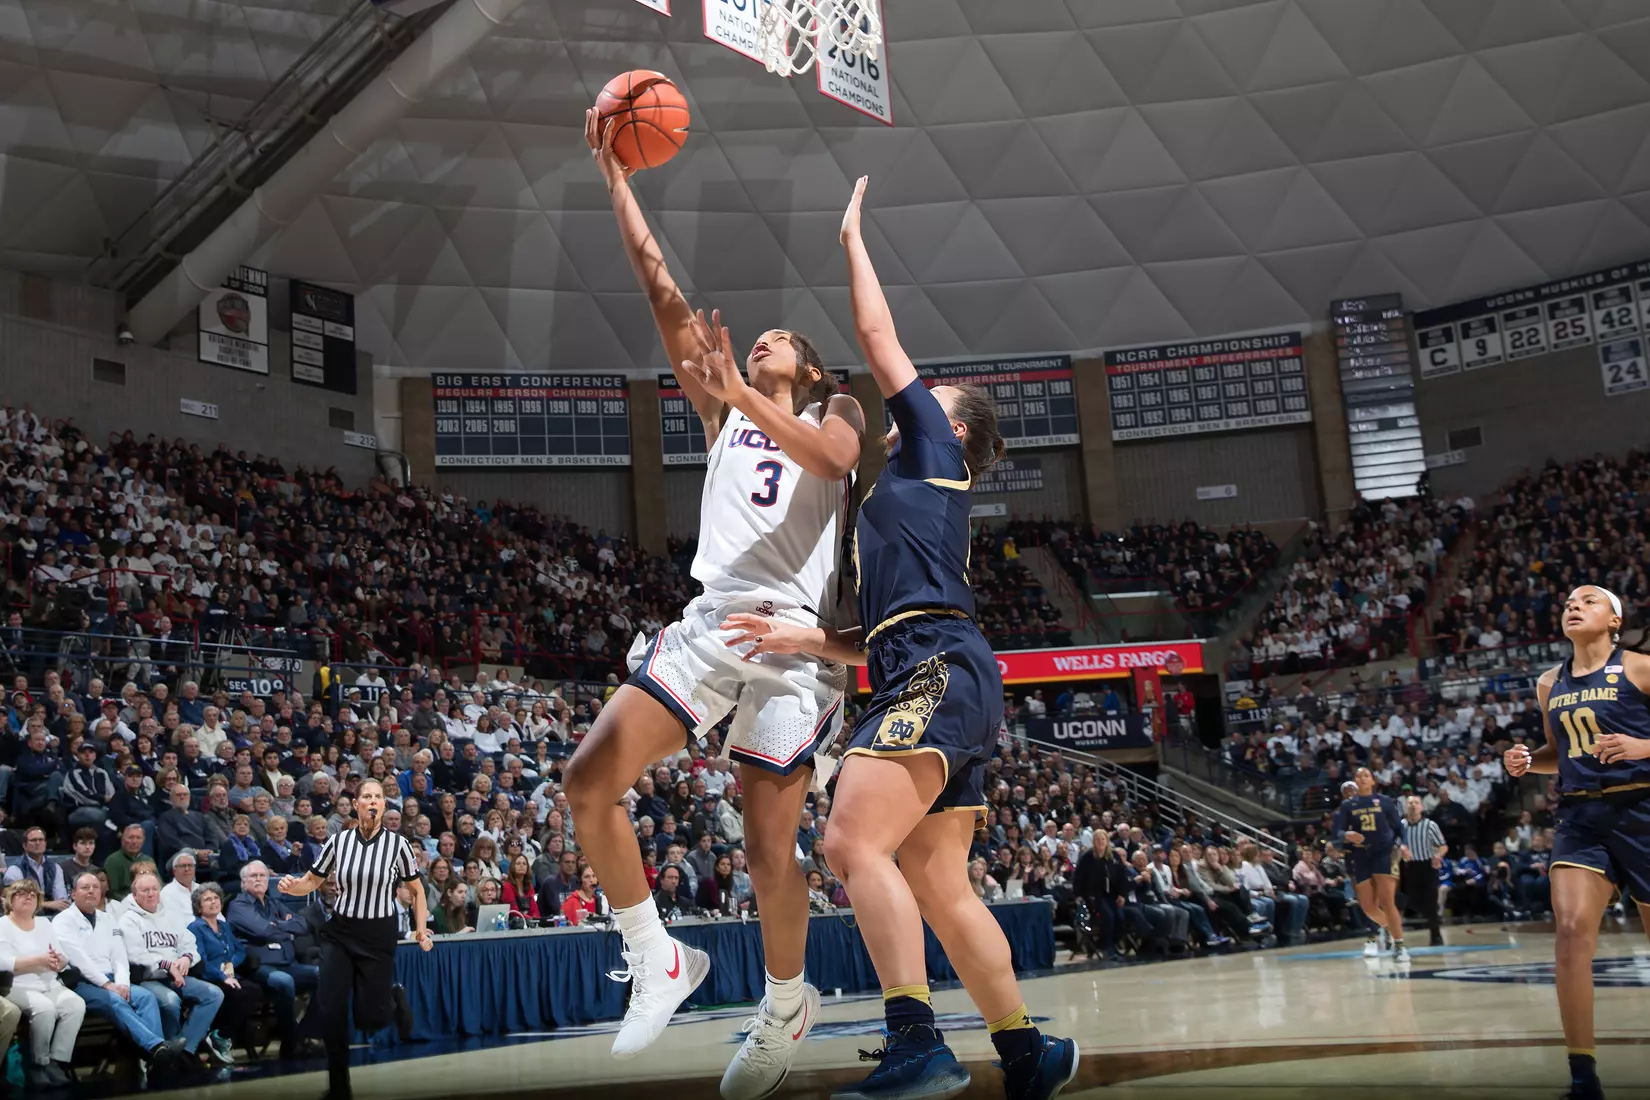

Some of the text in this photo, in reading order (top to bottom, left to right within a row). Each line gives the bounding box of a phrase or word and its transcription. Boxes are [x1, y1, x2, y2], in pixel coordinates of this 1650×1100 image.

[828, 41, 880, 80] 2016
[831, 67, 879, 98] NATIONAL
[828, 81, 884, 116] CHAMPIONS
[1486, 292, 1534, 307] UCONN
[1600, 307, 1633, 329] 42
[1553, 317, 1585, 340] 25
[1475, 338, 1487, 357] 9
[1509, 327, 1541, 350] 22
[1116, 336, 1290, 362] NCAA CHAMPIONSHIP
[1430, 347, 1448, 366] C
[940, 364, 994, 375] INVITATION
[997, 358, 1063, 371] TOURNAMENT
[1116, 348, 1294, 373] TOURNAMENT APPEARANCES
[1608, 360, 1641, 384] 24
[437, 376, 622, 387] BIG EAST CONFERENCE
[437, 389, 623, 397] REGULAR SEASON CHAMPIONS
[201, 405, 218, 417] 211
[465, 400, 486, 413] 1994
[494, 400, 514, 413] 1995
[577, 401, 597, 413] 1999
[603, 401, 625, 413] 2002
[437, 419, 459, 432] 2003
[664, 419, 685, 432] 2016
[1118, 425, 1192, 439] CONNECTICUT
[1234, 413, 1306, 427] BASKETBALL
[359, 431, 376, 446] 212
[1006, 435, 1074, 447] BASKETBALL
[751, 460, 783, 508] 3
[1224, 486, 1232, 496] 6
[1052, 653, 1115, 671] WELLS
[228, 680, 248, 690] SEC
[1581, 688, 1618, 702] DAME
[1053, 719, 1127, 739] UCONN
[1559, 706, 1603, 758] 10
[1360, 813, 1377, 831] 21
